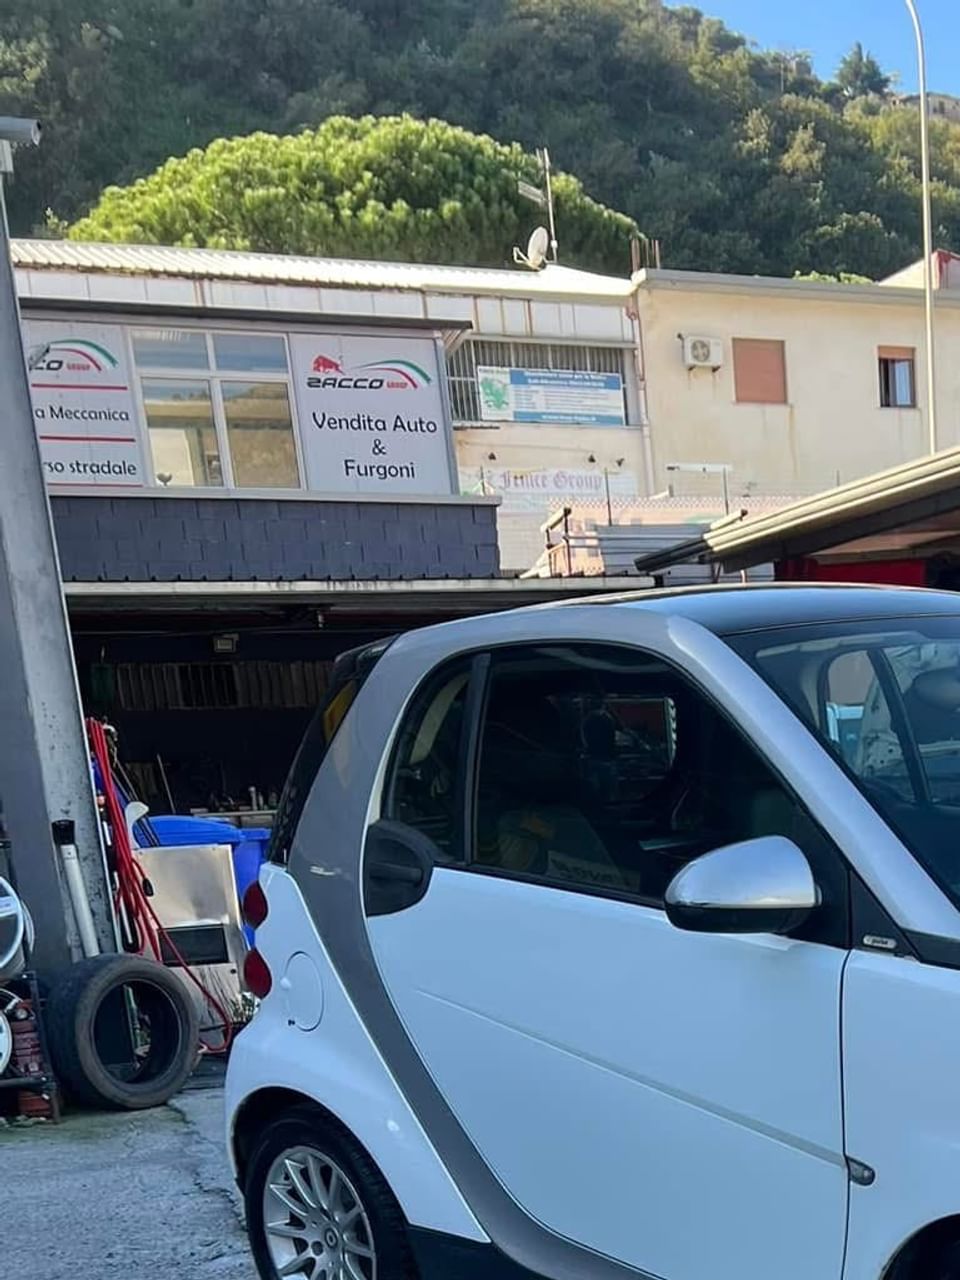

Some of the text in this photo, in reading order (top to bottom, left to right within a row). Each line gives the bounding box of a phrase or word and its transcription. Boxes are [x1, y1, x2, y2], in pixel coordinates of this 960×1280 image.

[49, 405, 130, 421] Meccanica
[312, 411, 438, 434] Vendita Auto
[371, 438, 388, 456] &
[68, 460, 137, 475] stradale
[343, 459, 416, 480] Furgoni
[553, 469, 602, 490] Group
